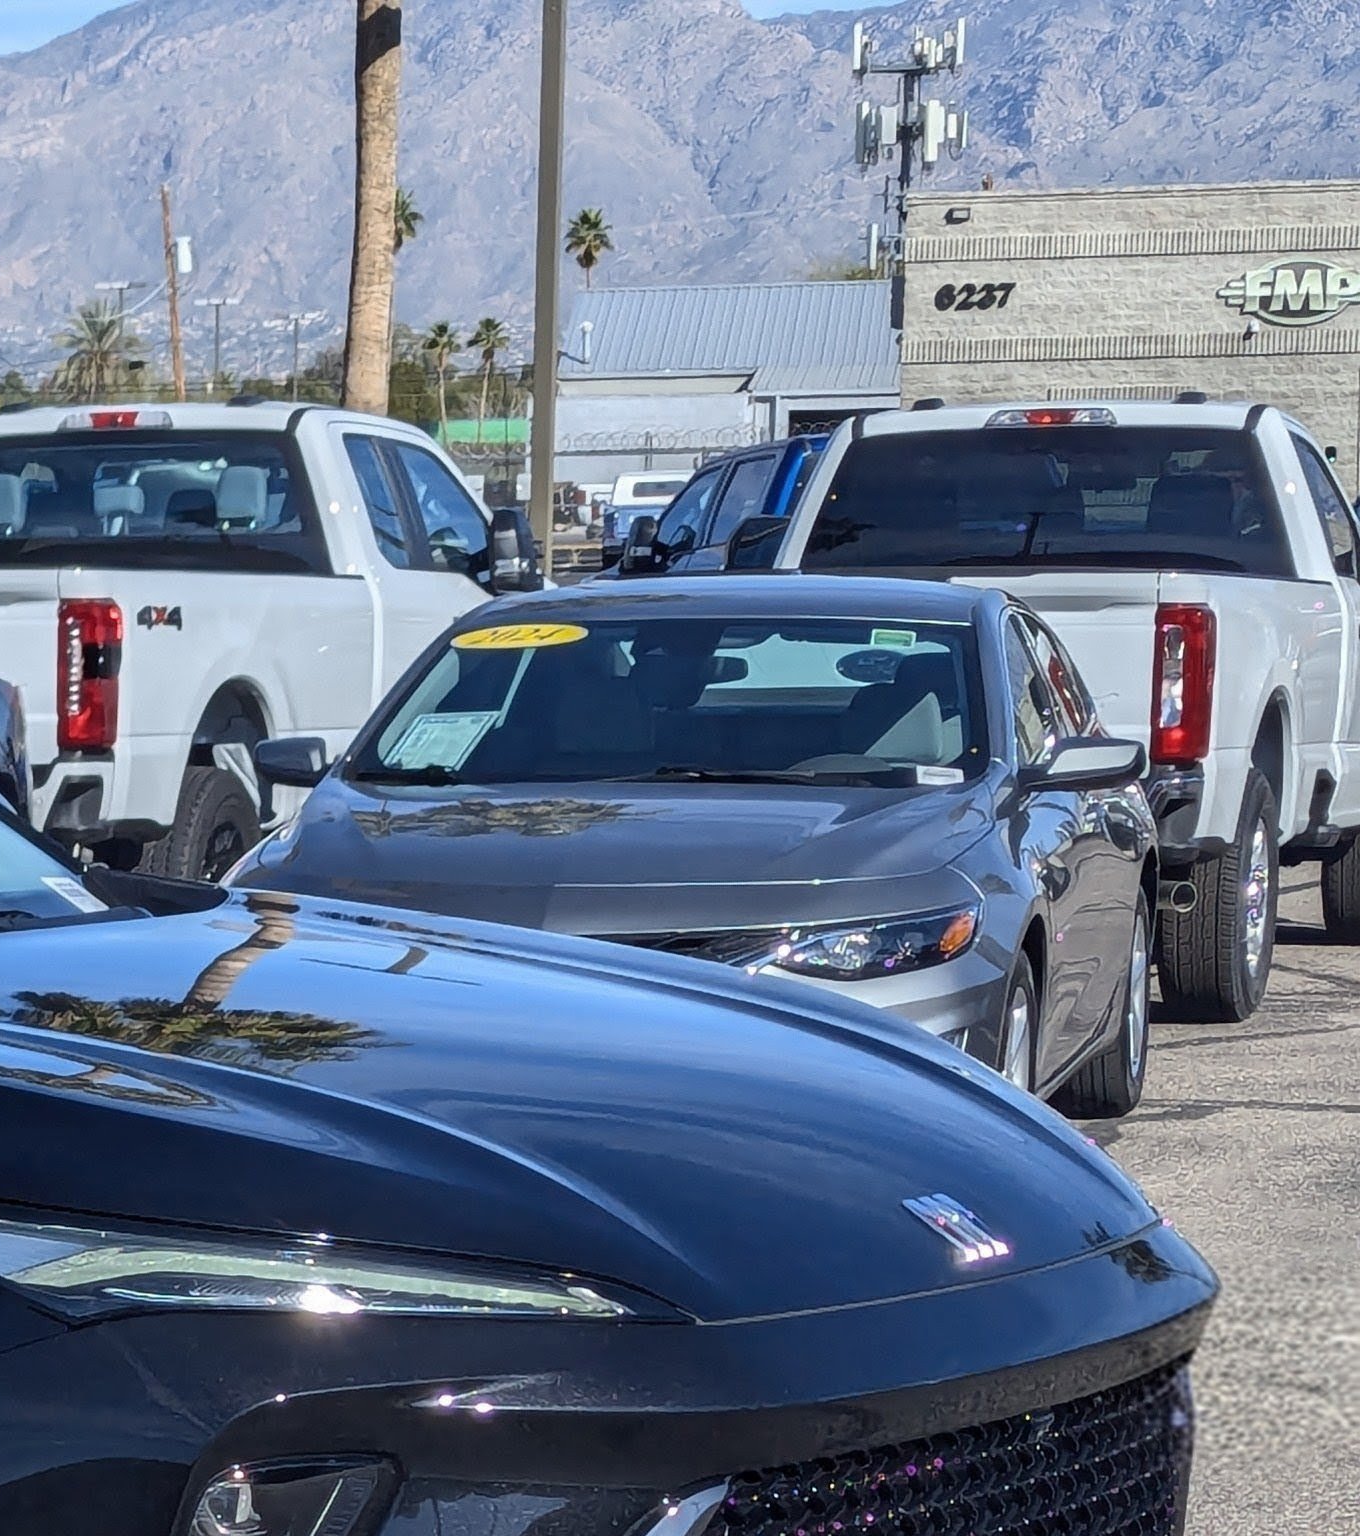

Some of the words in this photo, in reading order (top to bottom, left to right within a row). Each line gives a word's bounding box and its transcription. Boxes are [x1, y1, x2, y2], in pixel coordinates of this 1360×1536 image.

[934, 282, 1017, 312] 6237
[1243, 268, 1360, 312] FMP
[466, 627, 567, 645] 2024
